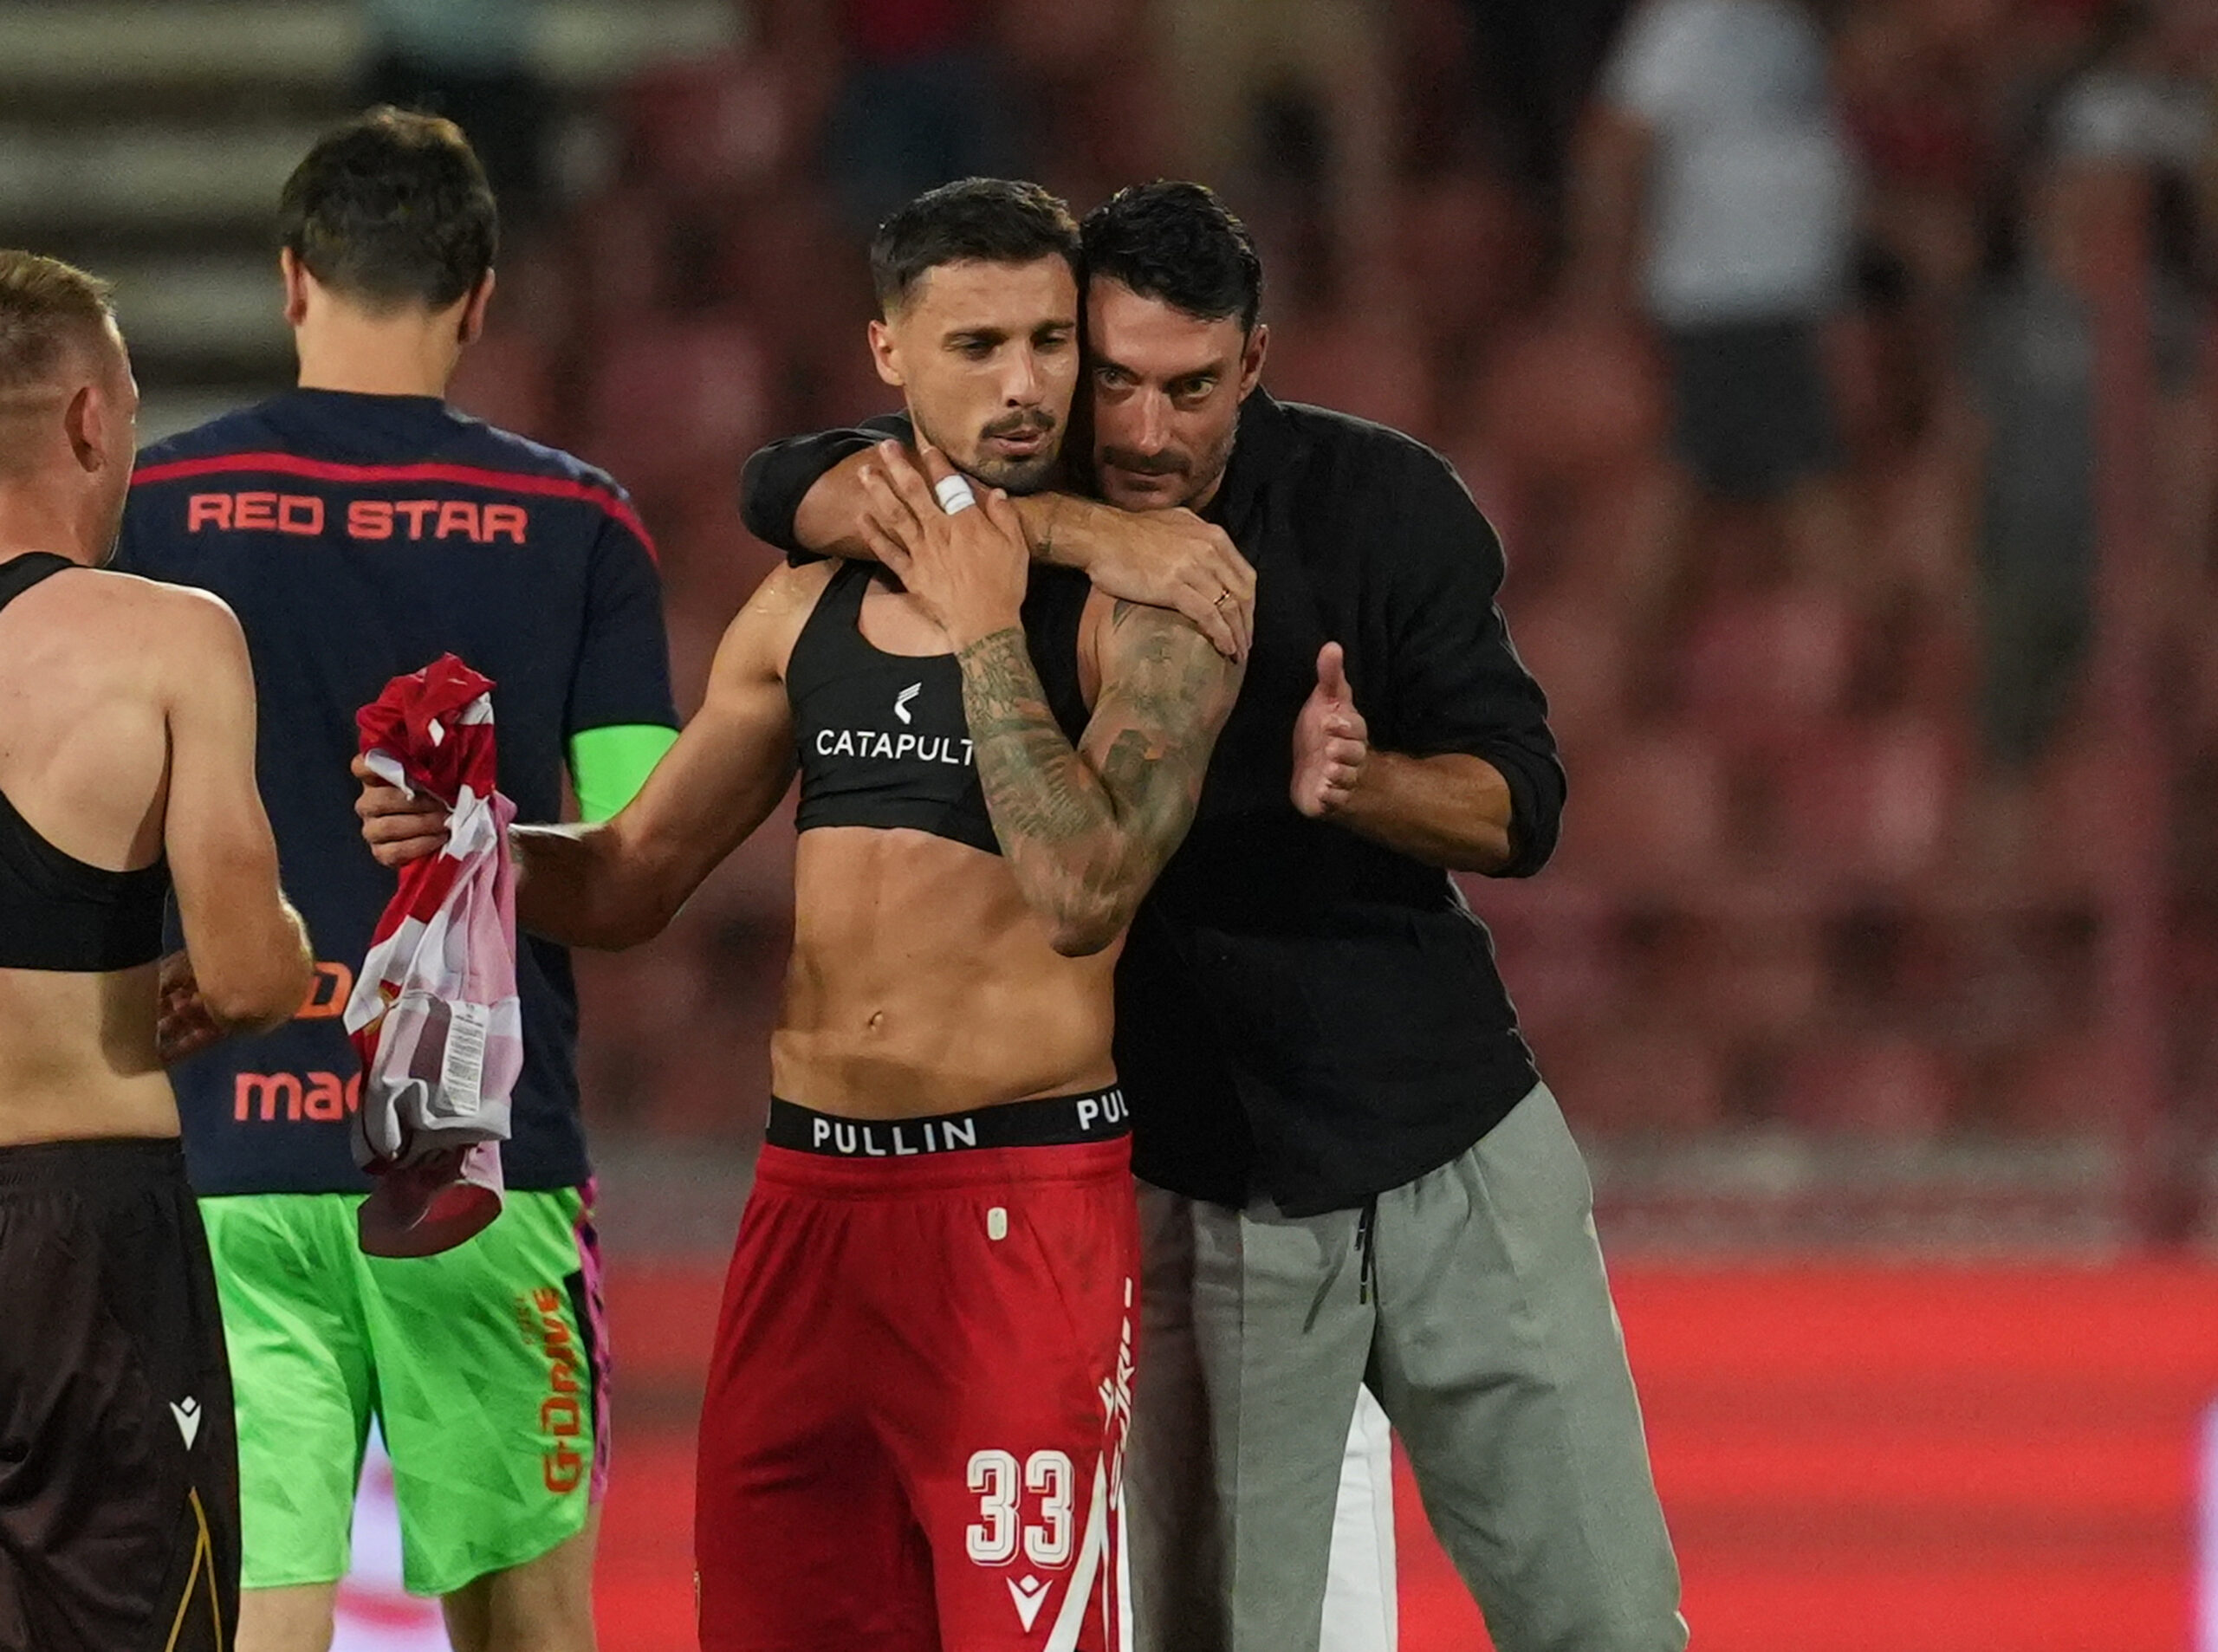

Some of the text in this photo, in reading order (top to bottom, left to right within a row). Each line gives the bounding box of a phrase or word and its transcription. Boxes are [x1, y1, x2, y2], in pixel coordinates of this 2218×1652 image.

[188, 491, 529, 545] RED STAR
[816, 729, 974, 767] CATAPULT
[813, 1118, 977, 1156] PULLIN
[965, 1448, 1076, 1571] 33
